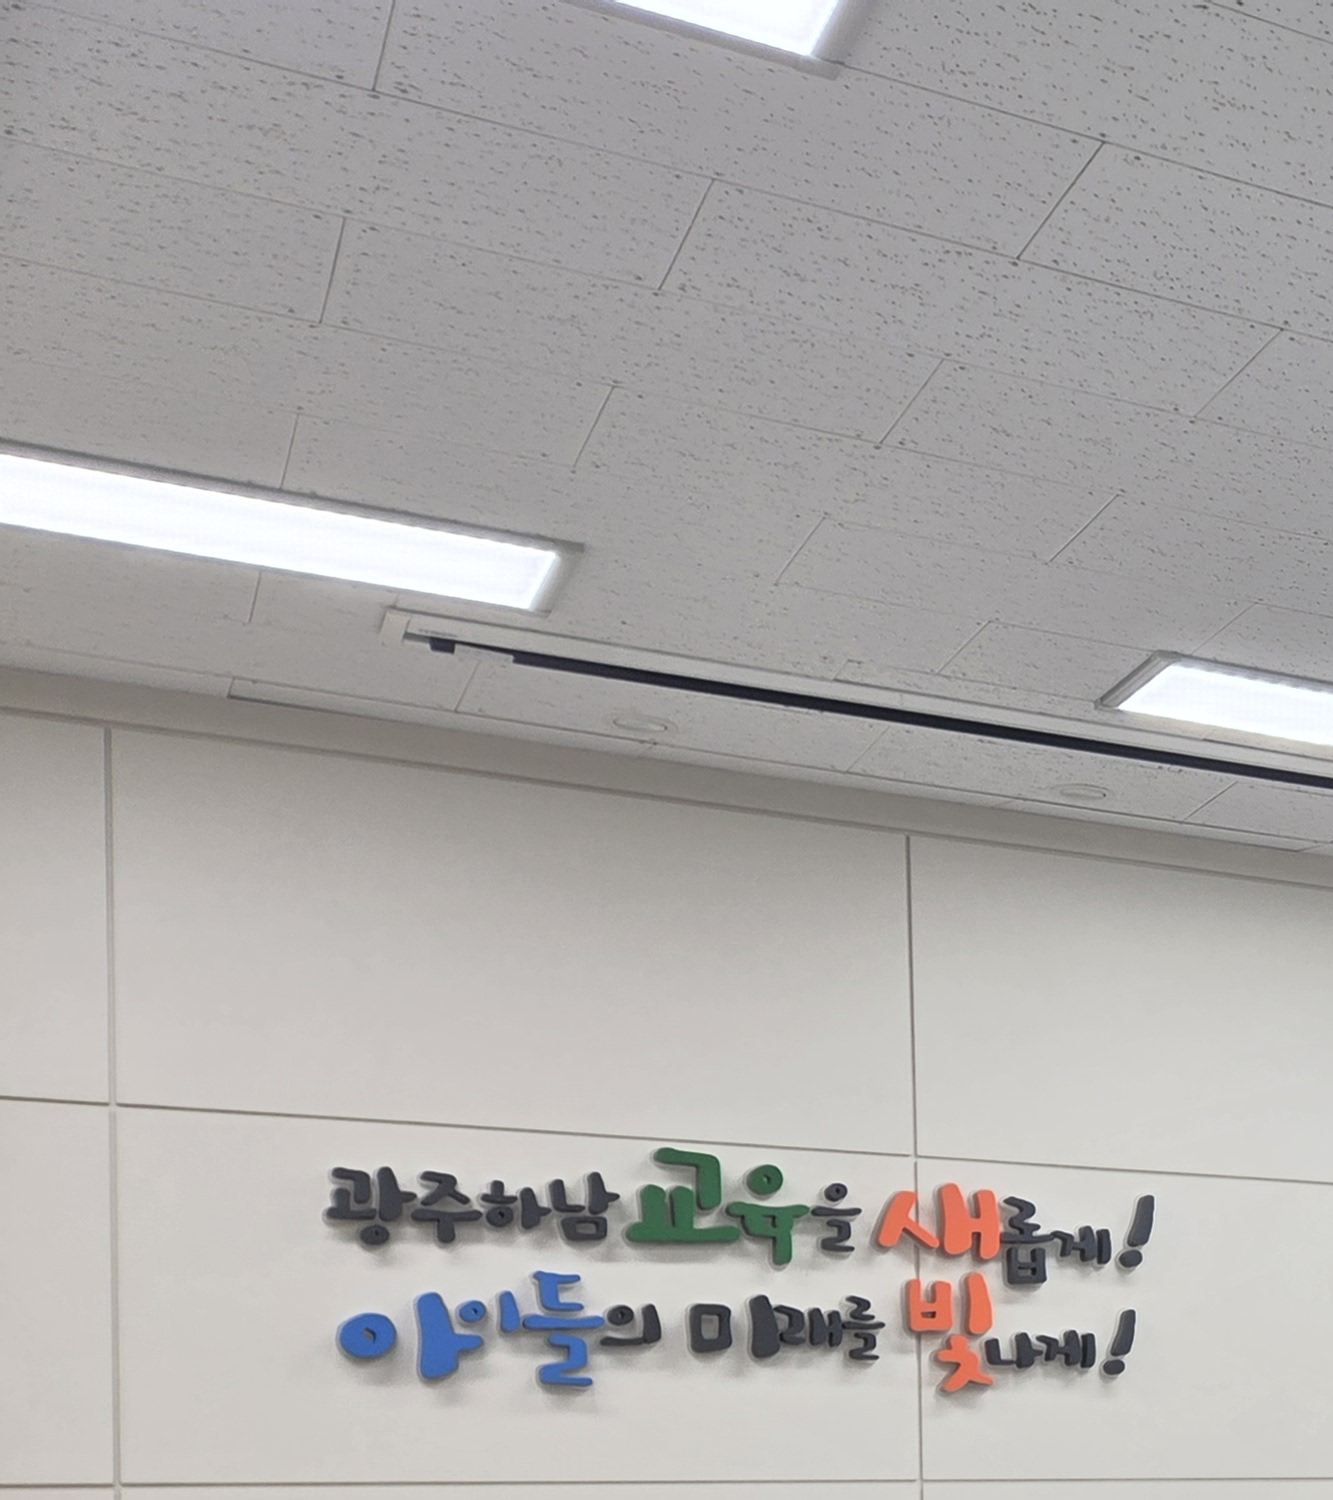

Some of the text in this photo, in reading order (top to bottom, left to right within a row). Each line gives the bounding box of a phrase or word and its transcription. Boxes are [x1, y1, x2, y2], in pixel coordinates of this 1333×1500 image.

[325, 1147, 1156, 1285] 광주하남 교육을 새롭게!
[339, 1270, 1136, 1392] 아이들의 미래를 빛나게!
